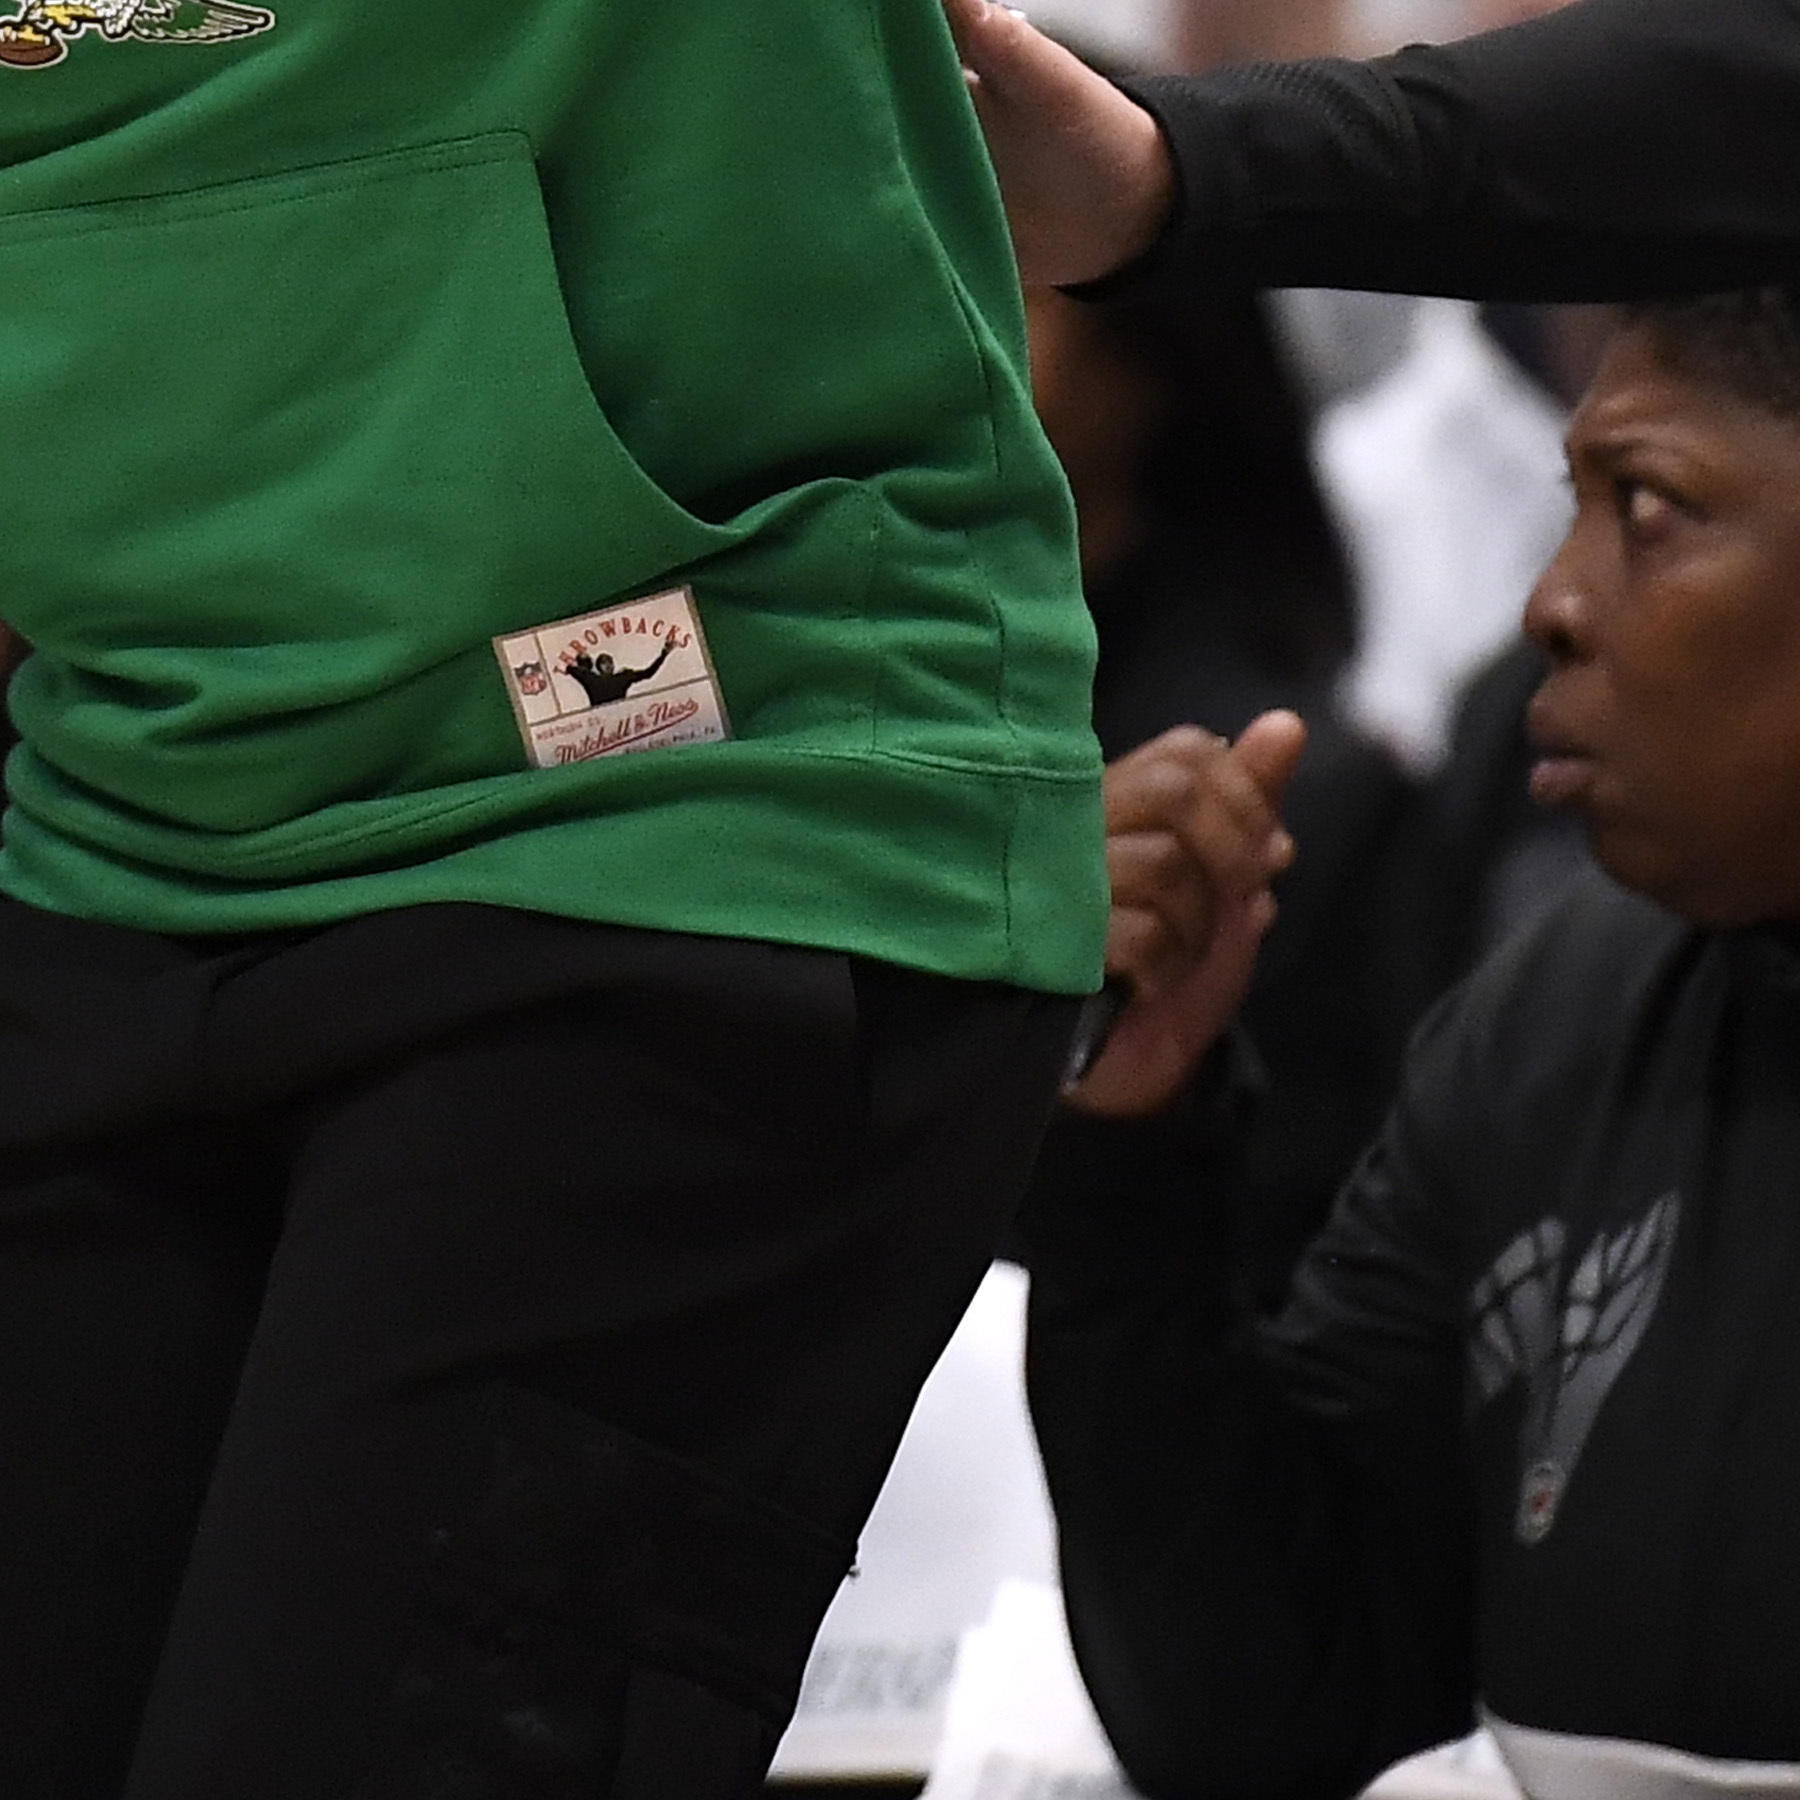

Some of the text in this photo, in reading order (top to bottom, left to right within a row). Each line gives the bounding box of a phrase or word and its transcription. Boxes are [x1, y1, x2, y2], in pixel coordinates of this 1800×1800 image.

[552, 616, 692, 676] THROWBACKS
[556, 717, 631, 764] Mitchell
[648, 696, 699, 726] Ness
